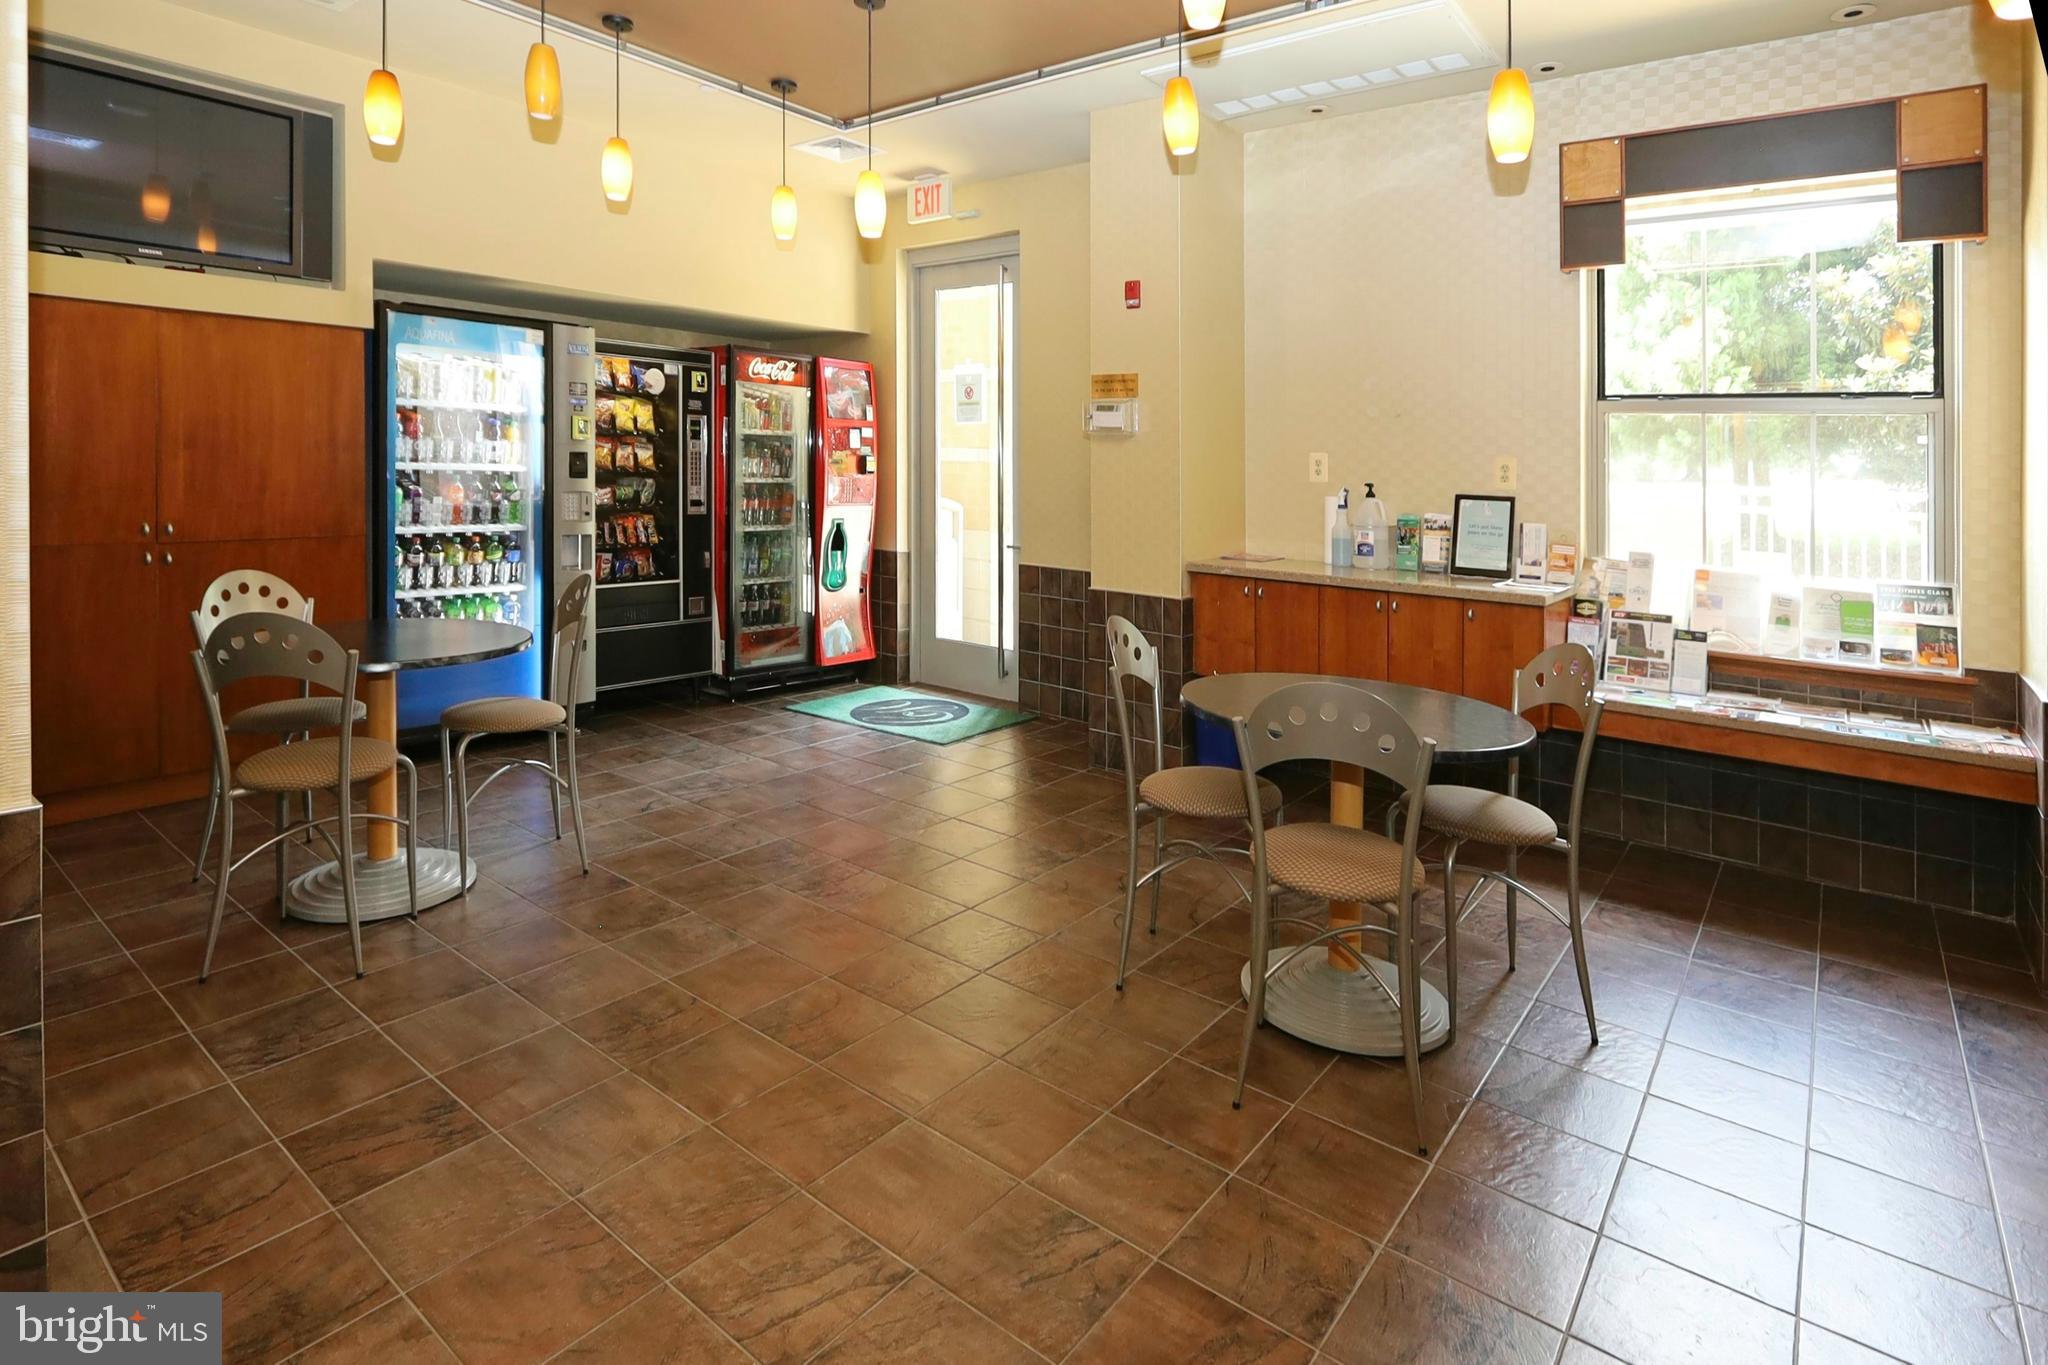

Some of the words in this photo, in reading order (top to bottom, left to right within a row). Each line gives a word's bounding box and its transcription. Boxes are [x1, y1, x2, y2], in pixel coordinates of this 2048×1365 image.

[914, 183, 943, 217] EXIT
[404, 326, 457, 345] AQUAFINA
[1898, 587, 1925, 595] FITNESS
